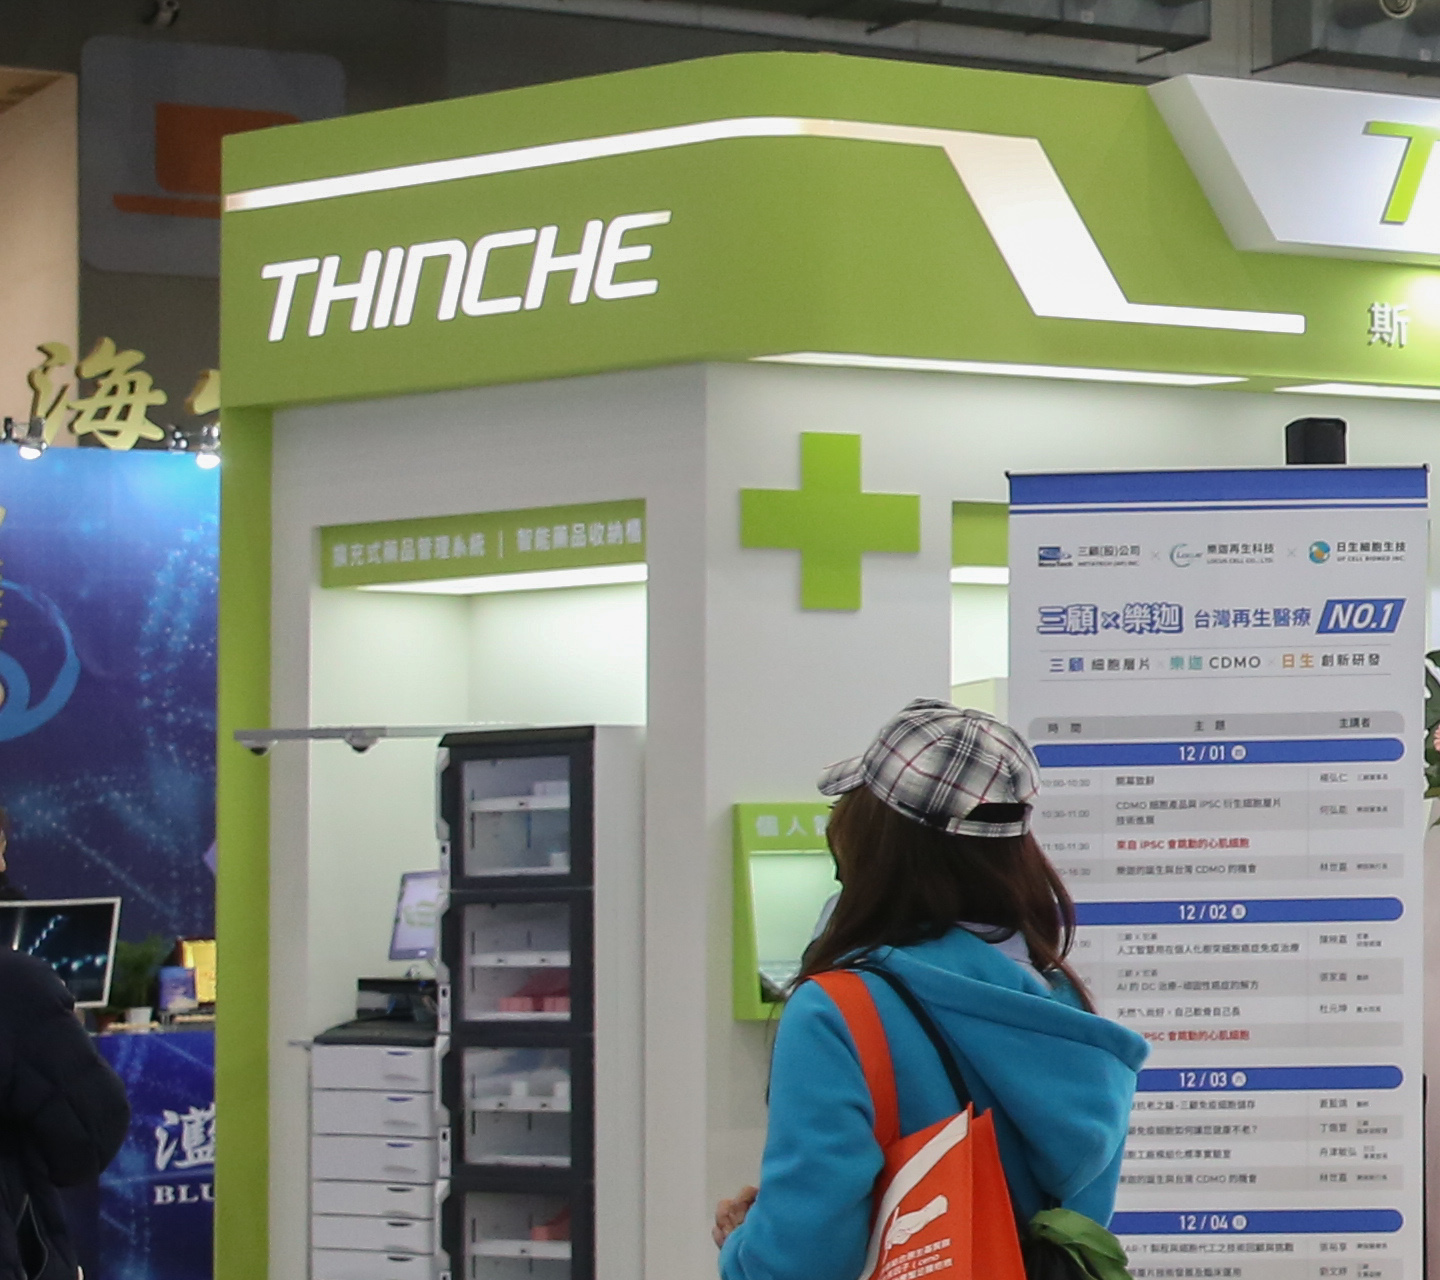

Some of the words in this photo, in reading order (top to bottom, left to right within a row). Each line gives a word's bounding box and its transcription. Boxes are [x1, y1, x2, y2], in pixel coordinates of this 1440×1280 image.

[261, 210, 672, 343] THINCHE
[1337, 541, 1406, 552] 日生細胞生技
[1194, 607, 1312, 629] 台灣再生醫療
[1327, 602, 1395, 630] NO.1
[1209, 656, 1261, 669] CDMO
[1282, 654, 1314, 669] 日生
[1321, 654, 1380, 667] 創新研發
